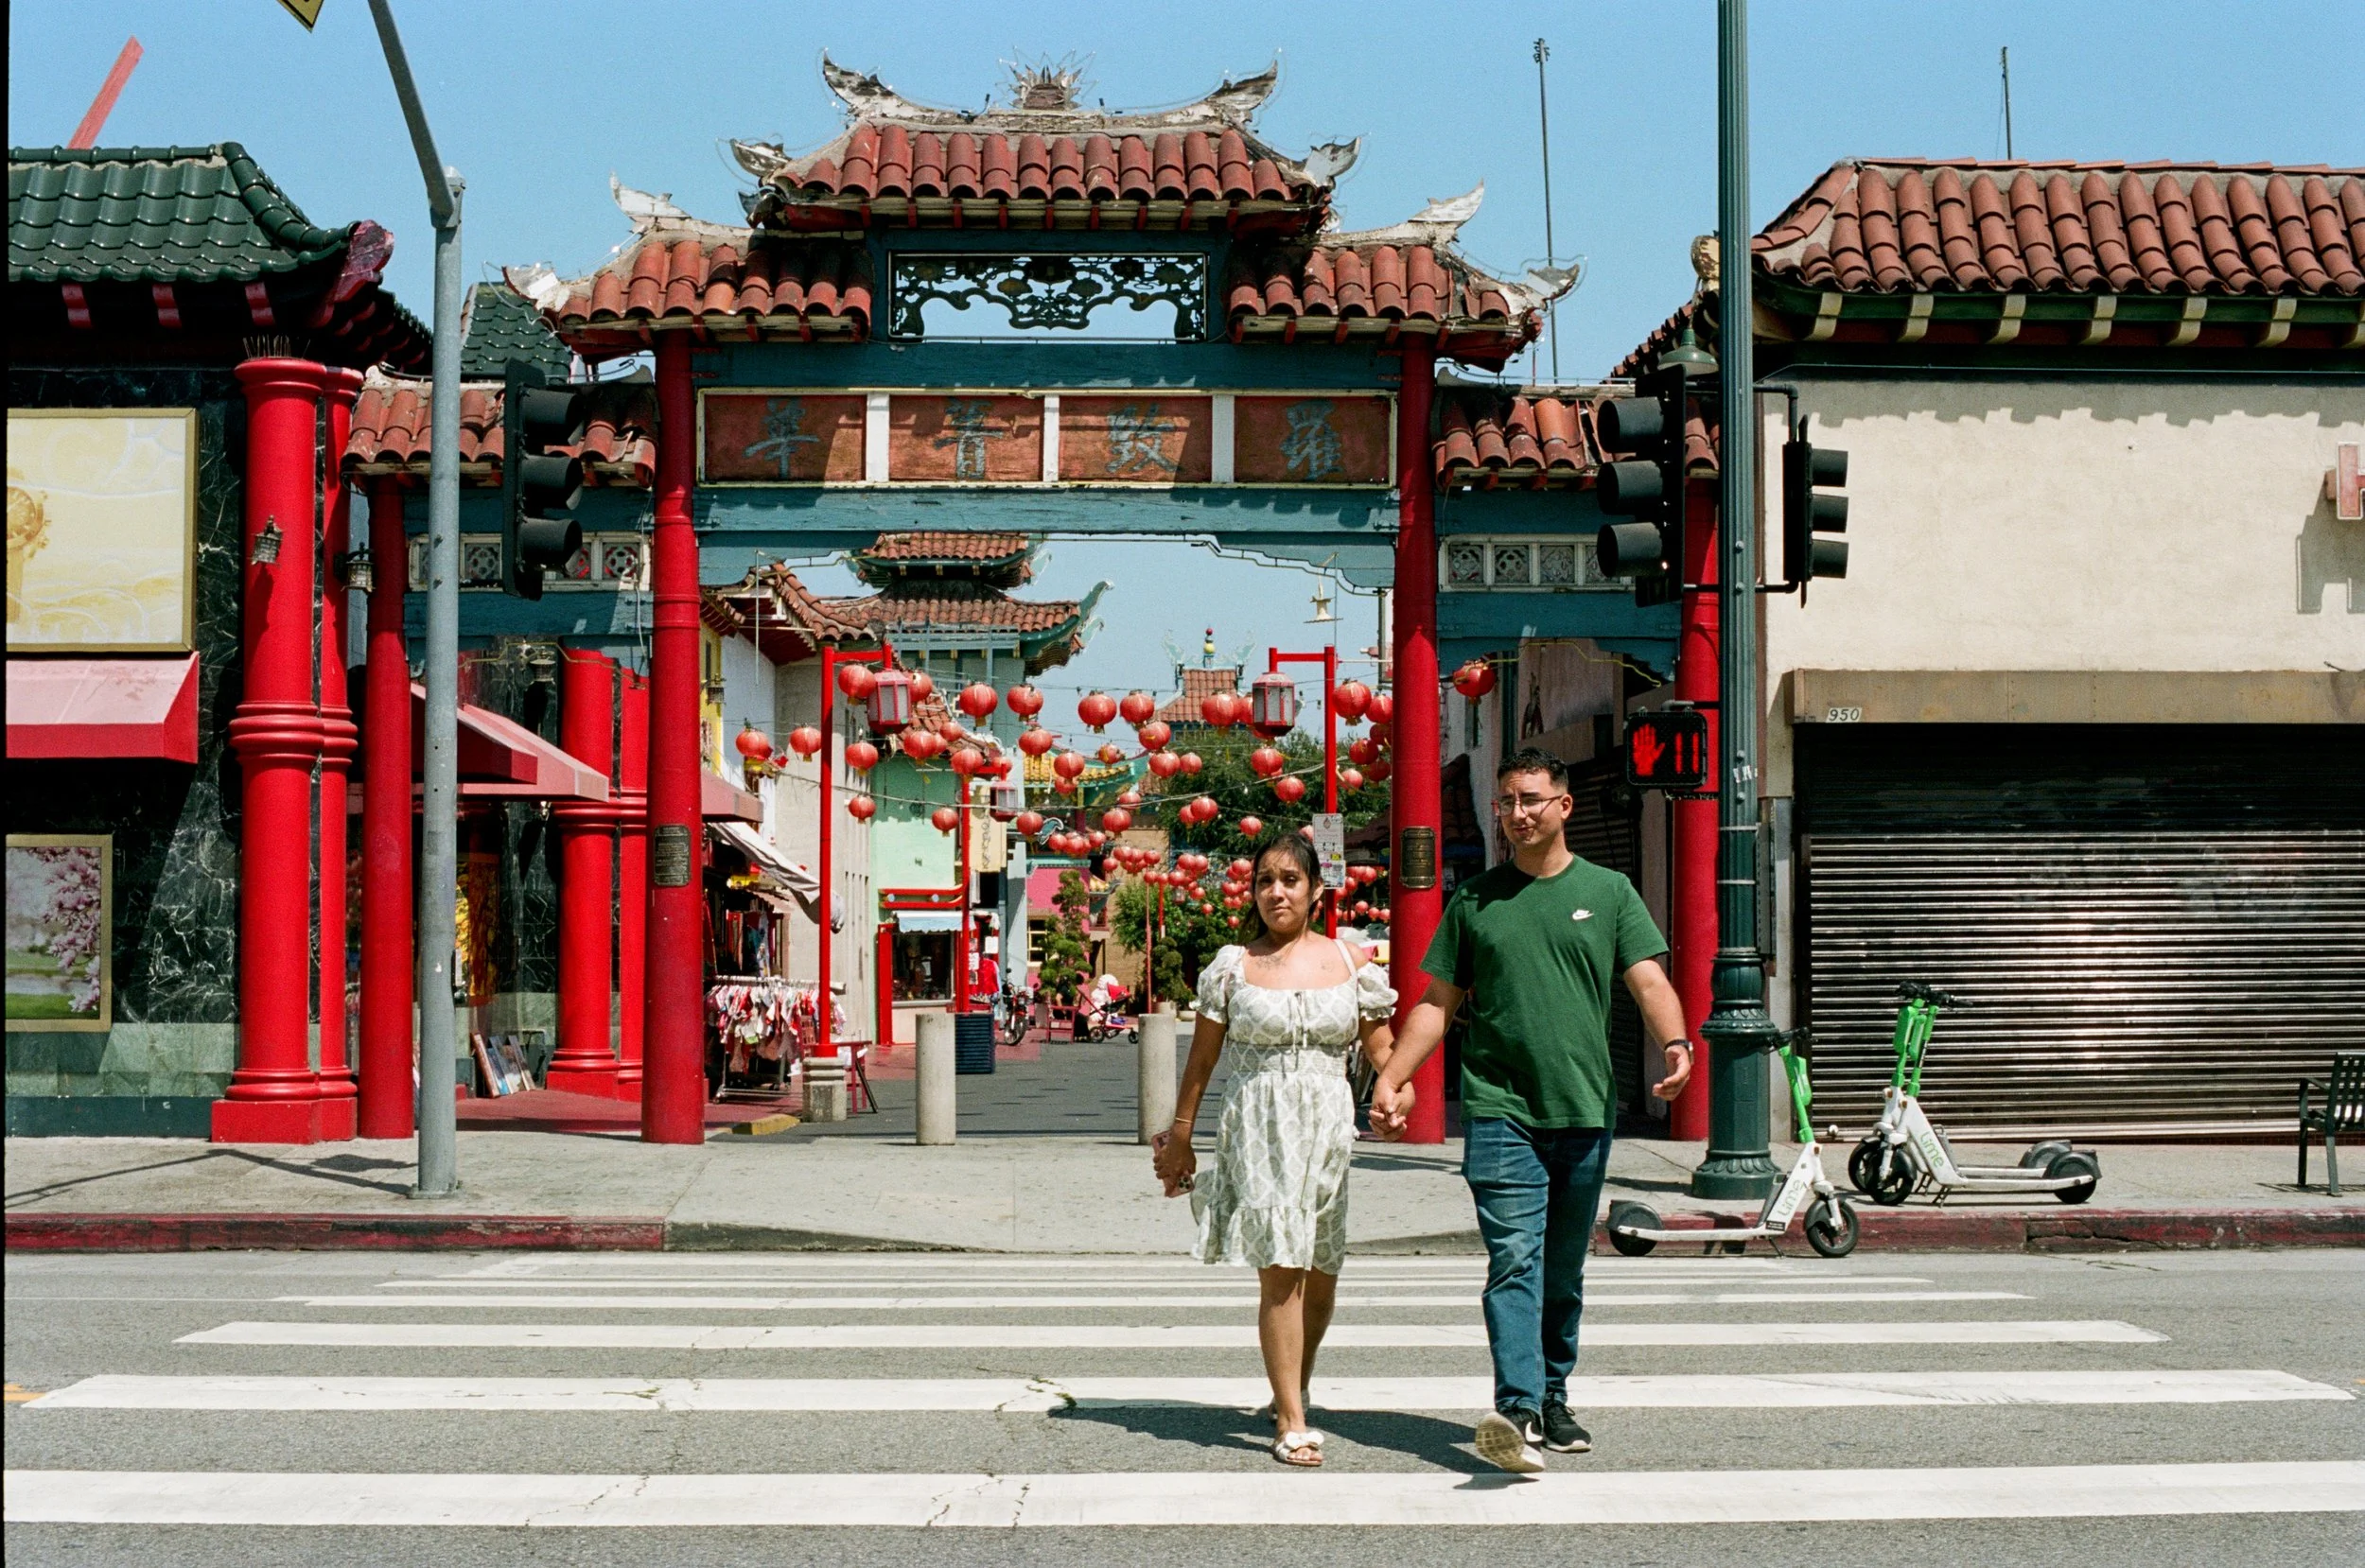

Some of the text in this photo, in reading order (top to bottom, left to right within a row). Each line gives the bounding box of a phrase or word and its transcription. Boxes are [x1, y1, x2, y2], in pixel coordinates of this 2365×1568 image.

[1829, 708, 1860, 722] 950
[1674, 732, 1700, 775] 11
[1919, 1131, 1945, 1168] Lime
